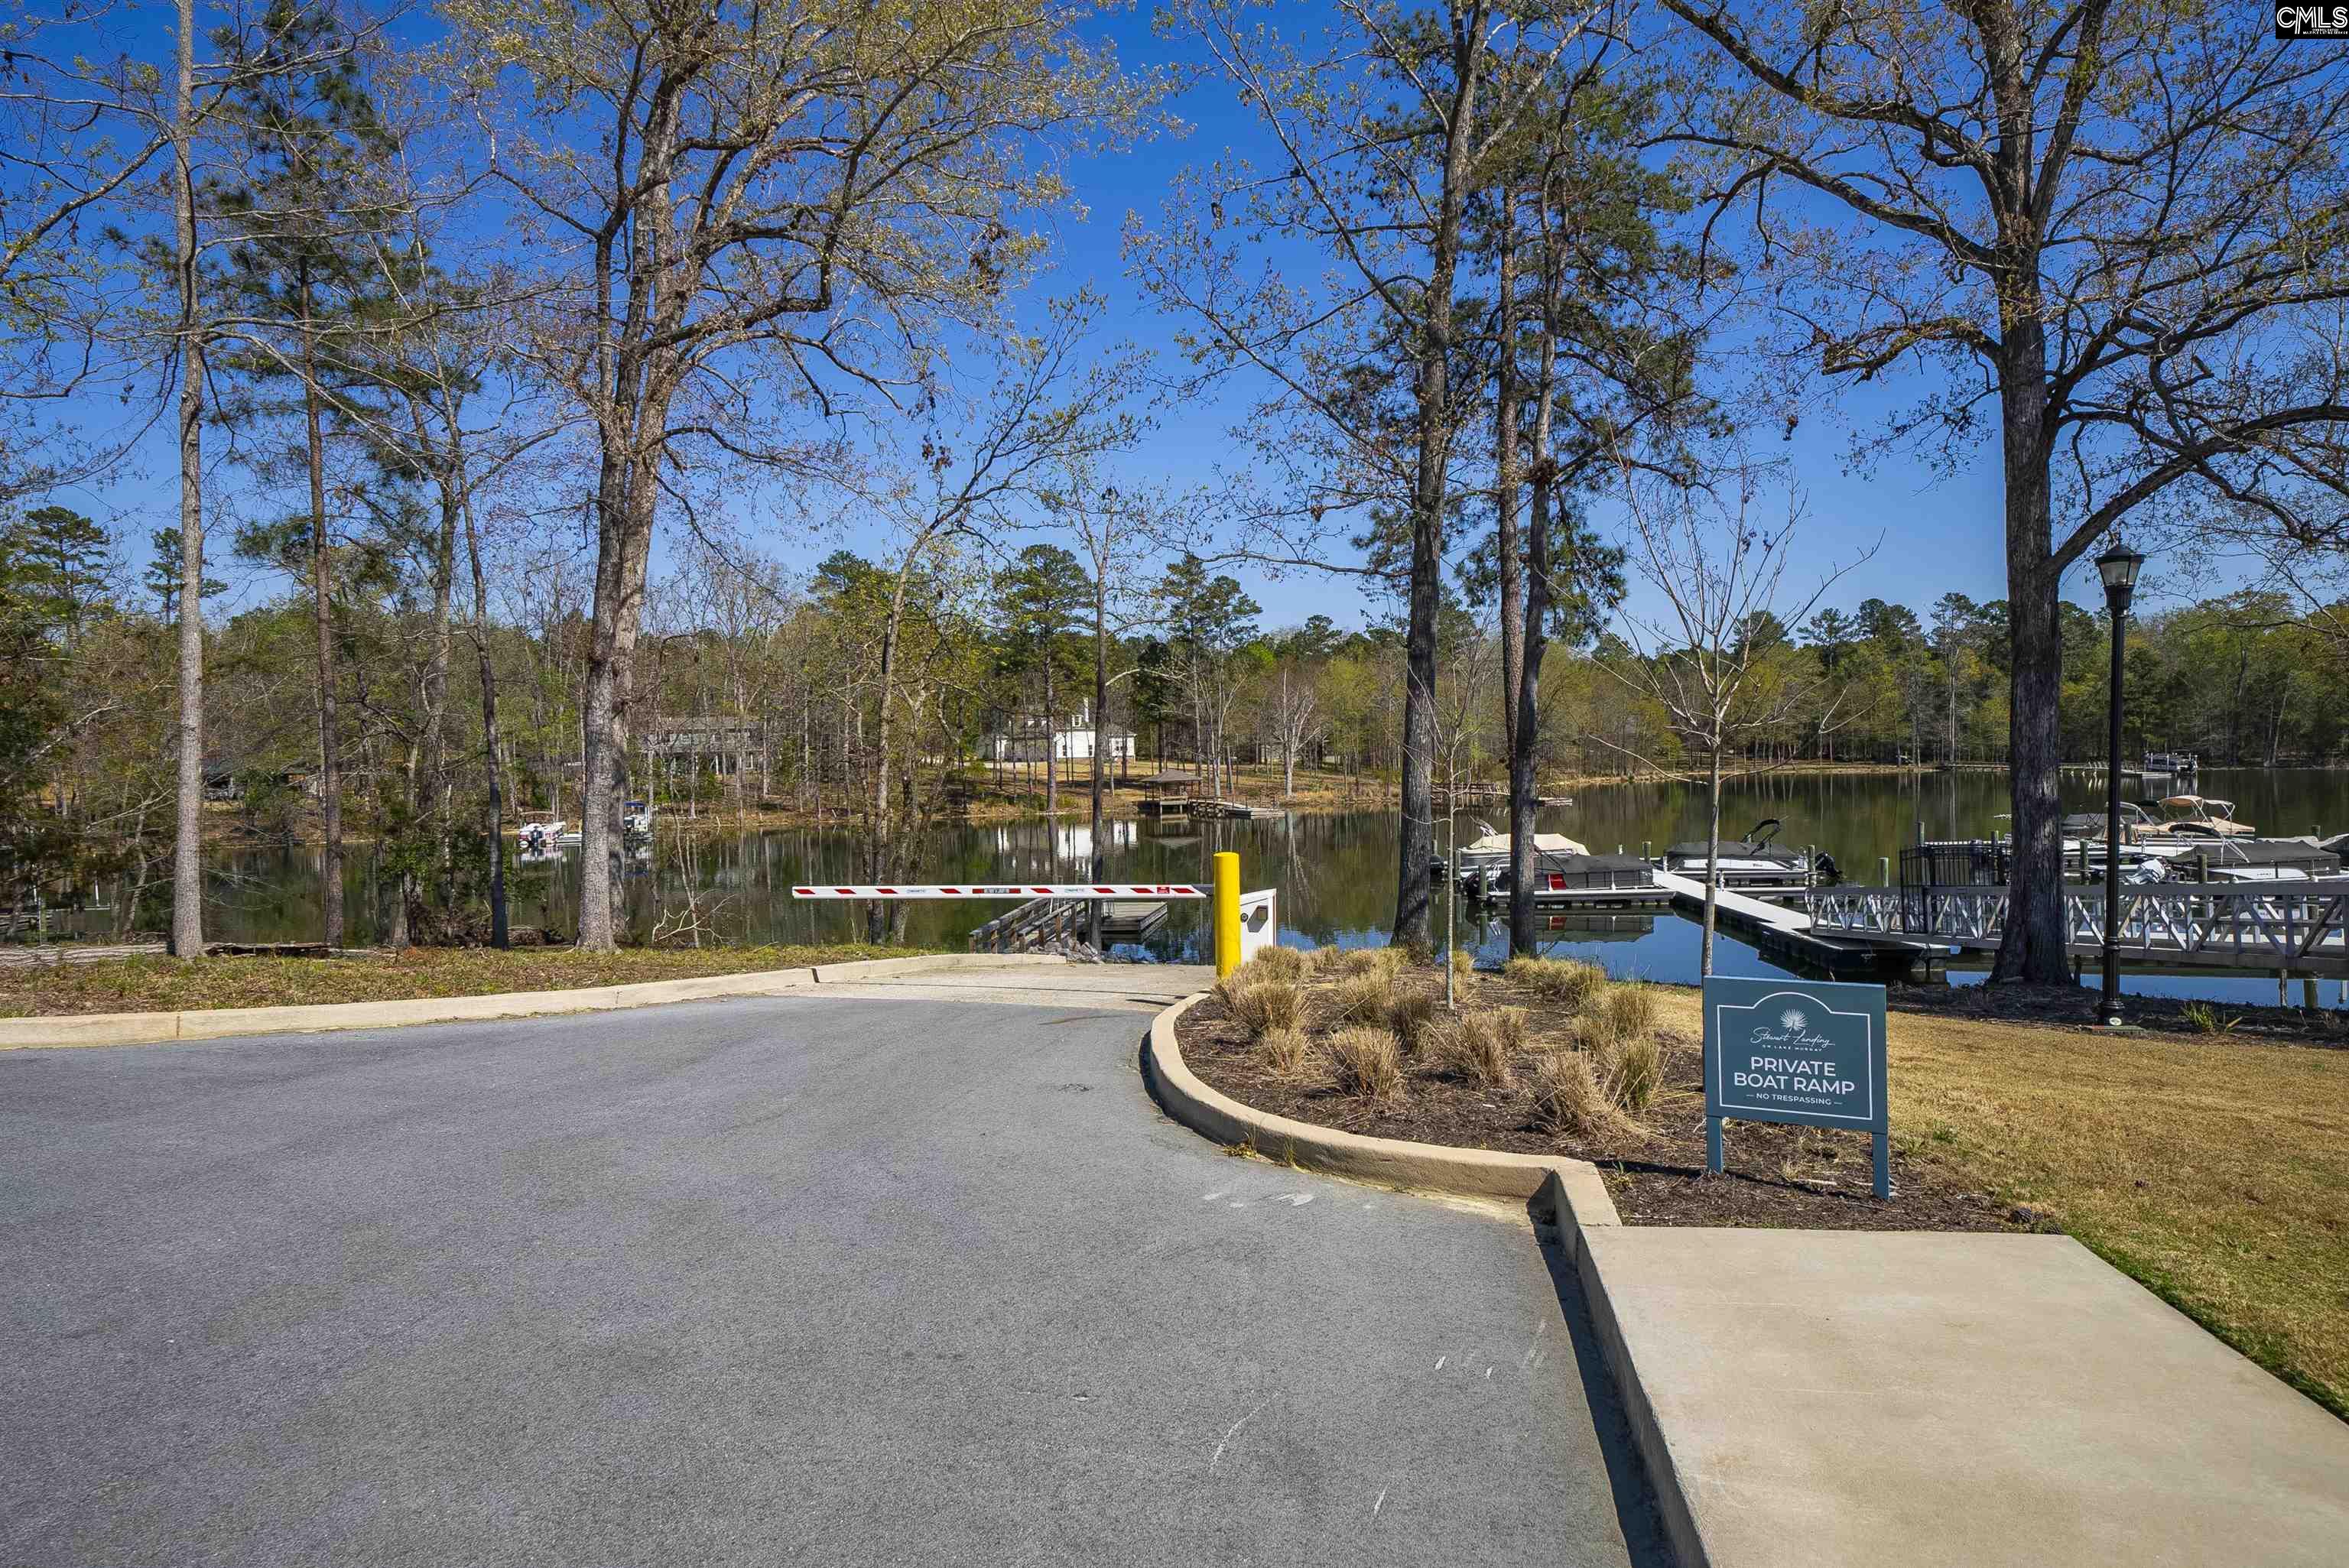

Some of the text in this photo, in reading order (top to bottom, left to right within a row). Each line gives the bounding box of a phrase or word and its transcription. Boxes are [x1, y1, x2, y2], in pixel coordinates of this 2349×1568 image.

[1750, 1027, 1835, 1048] Stewart Landing
[1750, 1057, 1836, 1076] PRIVATE
[1733, 1072, 1855, 1095] BOAT RAMP
[1772, 1094, 1832, 1105] TRESPASSING
